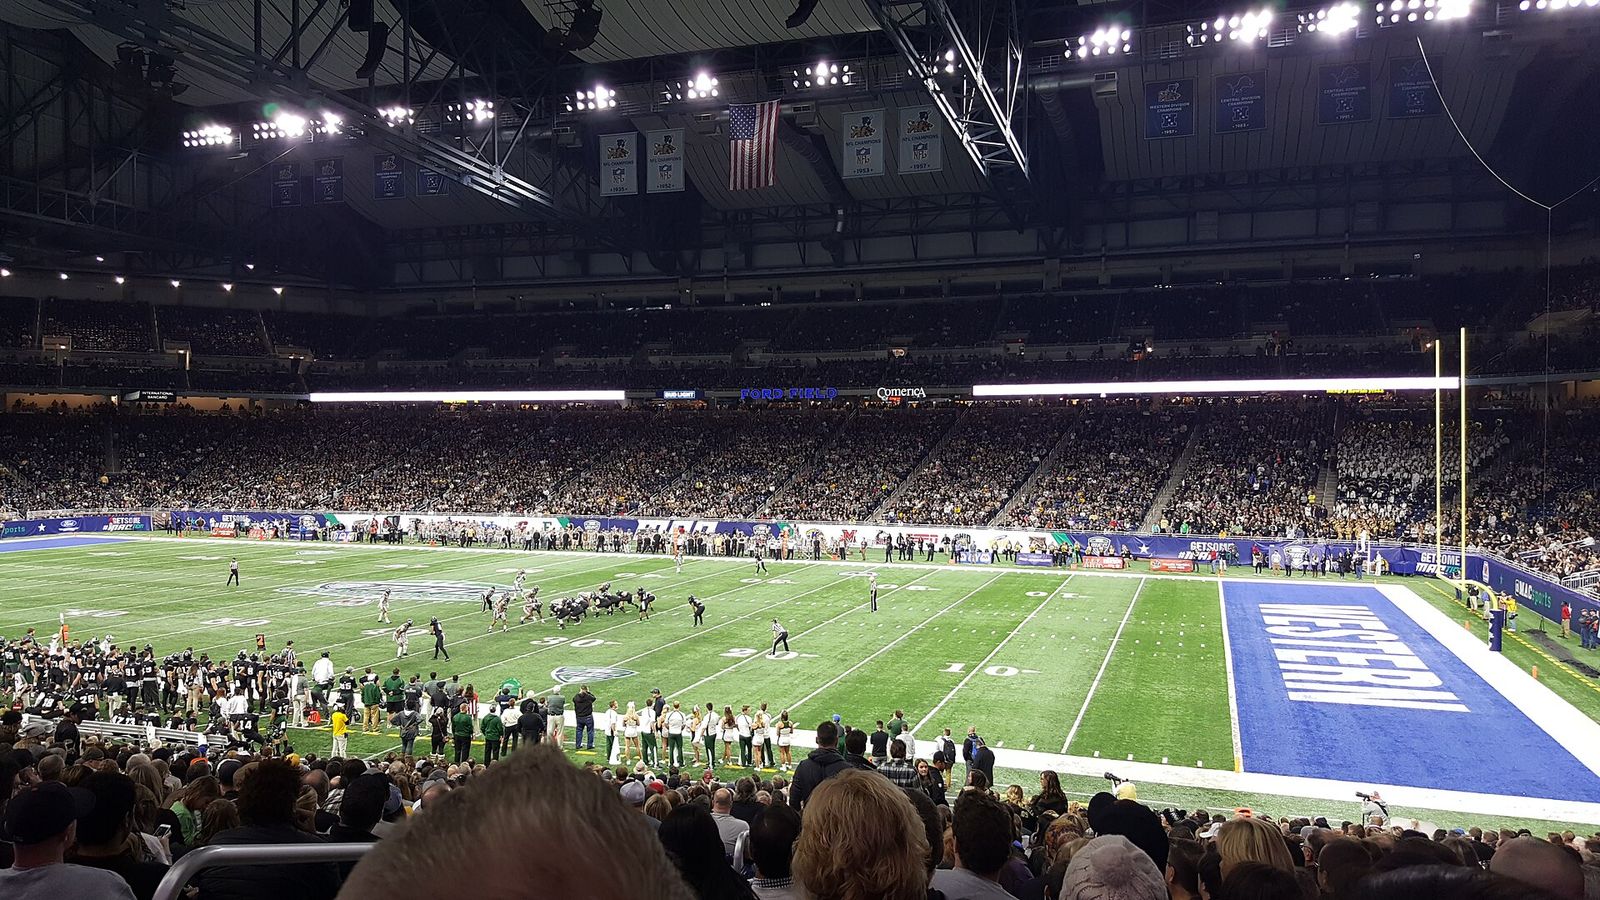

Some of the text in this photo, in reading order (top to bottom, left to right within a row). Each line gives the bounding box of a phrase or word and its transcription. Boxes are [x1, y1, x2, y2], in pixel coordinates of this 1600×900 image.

[740, 388, 838, 399] FORD FIELD
[1421, 552, 1461, 565] GETOME
[1259, 603, 1470, 712] WESTERN
[939, 662, 1020, 677] 10
[82, 673, 96, 681] 44
[239, 720, 253, 730] 14
